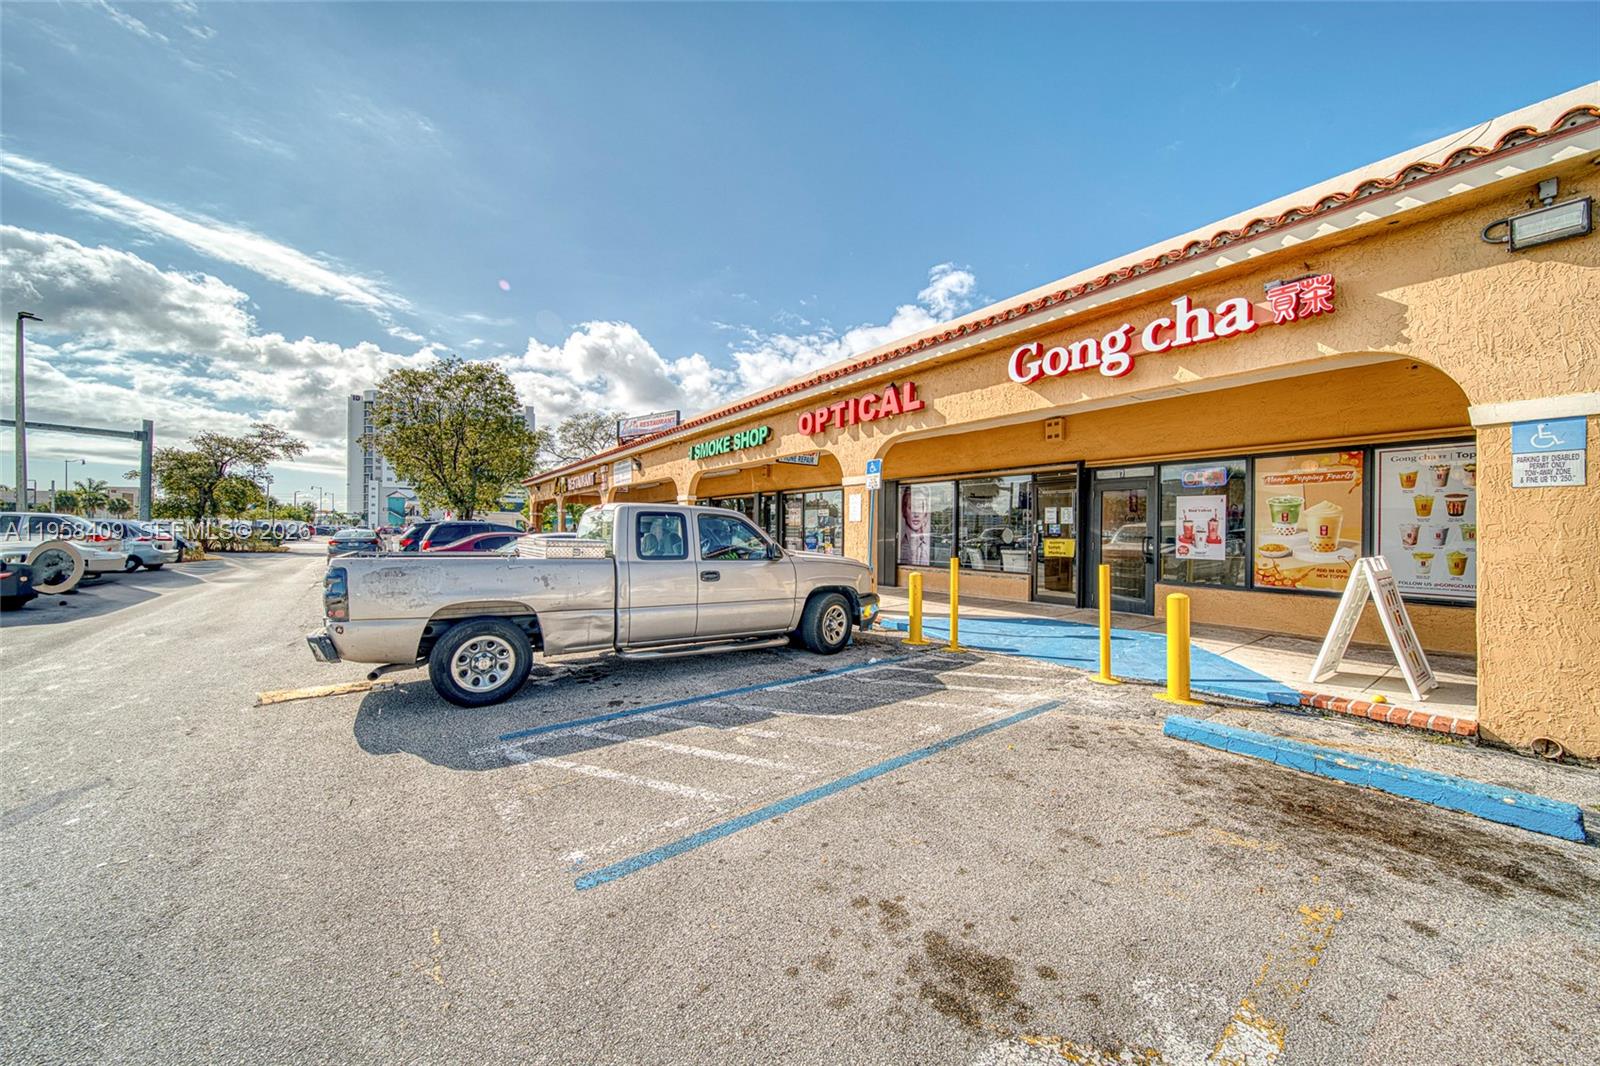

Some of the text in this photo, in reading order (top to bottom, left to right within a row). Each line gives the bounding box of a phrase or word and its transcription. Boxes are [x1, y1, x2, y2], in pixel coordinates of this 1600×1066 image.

[1008, 295, 1257, 384] Gong cha
[798, 381, 924, 436] OPTICAL
[694, 434, 731, 460] SMOKE
[733, 425, 768, 451] SHOP
[1390, 455, 1417, 463] Gong
[1516, 455, 1540, 463] PARKING
[1551, 453, 1580, 461] DISABLED
[1556, 467, 1571, 475] ZONE
[1292, 473, 1324, 482] Popping
